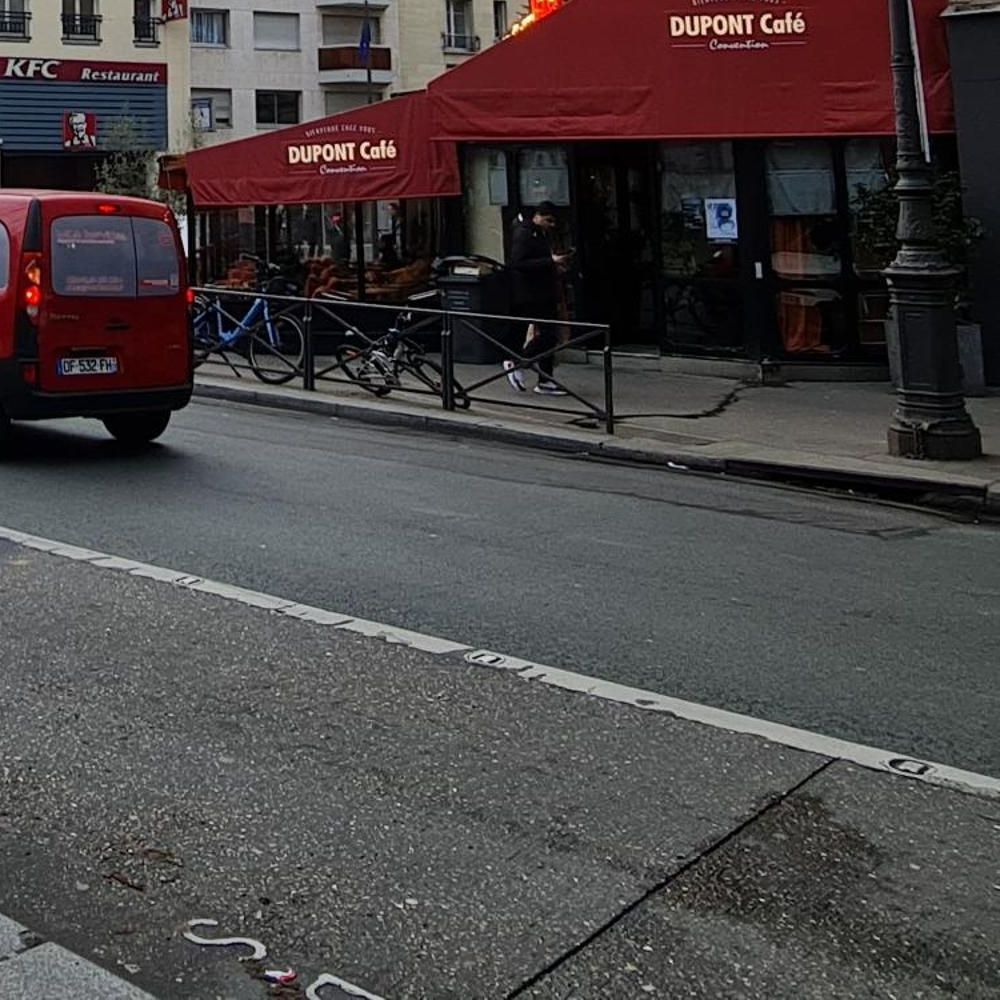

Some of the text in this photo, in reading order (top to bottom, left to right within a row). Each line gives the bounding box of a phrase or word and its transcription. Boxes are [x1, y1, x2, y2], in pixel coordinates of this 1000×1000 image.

[669, 11, 806, 37] DUPONT Café
[708, 38, 770, 51] Convention
[3, 58, 62, 79] KFC
[80, 67, 160, 83] Restaurant
[287, 139, 397, 164] DUPONT Café
